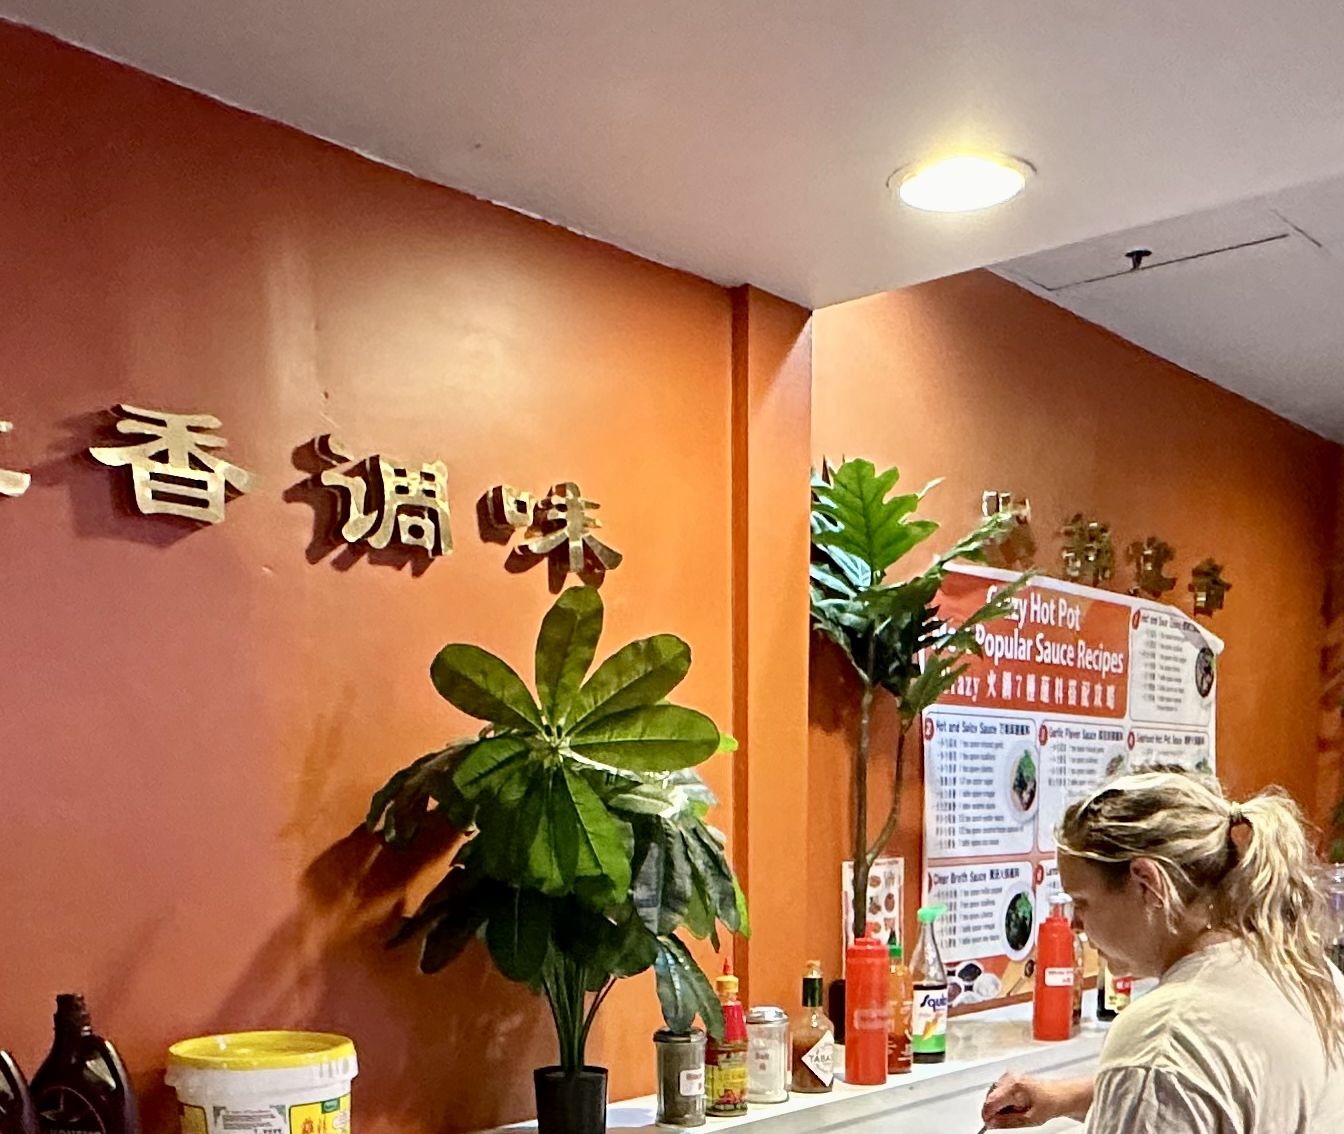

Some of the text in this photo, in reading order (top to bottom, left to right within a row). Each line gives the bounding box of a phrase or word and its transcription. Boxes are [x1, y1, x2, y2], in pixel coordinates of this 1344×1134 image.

[1030, 592, 1055, 625] Hot
[1058, 598, 1080, 631] Pot
[975, 624, 1033, 666] Popular
[1036, 633, 1074, 666] Sauce
[1077, 640, 1124, 678] Recipes
[944, 675, 980, 702] razy
[808, 1053, 832, 1063] TABA
